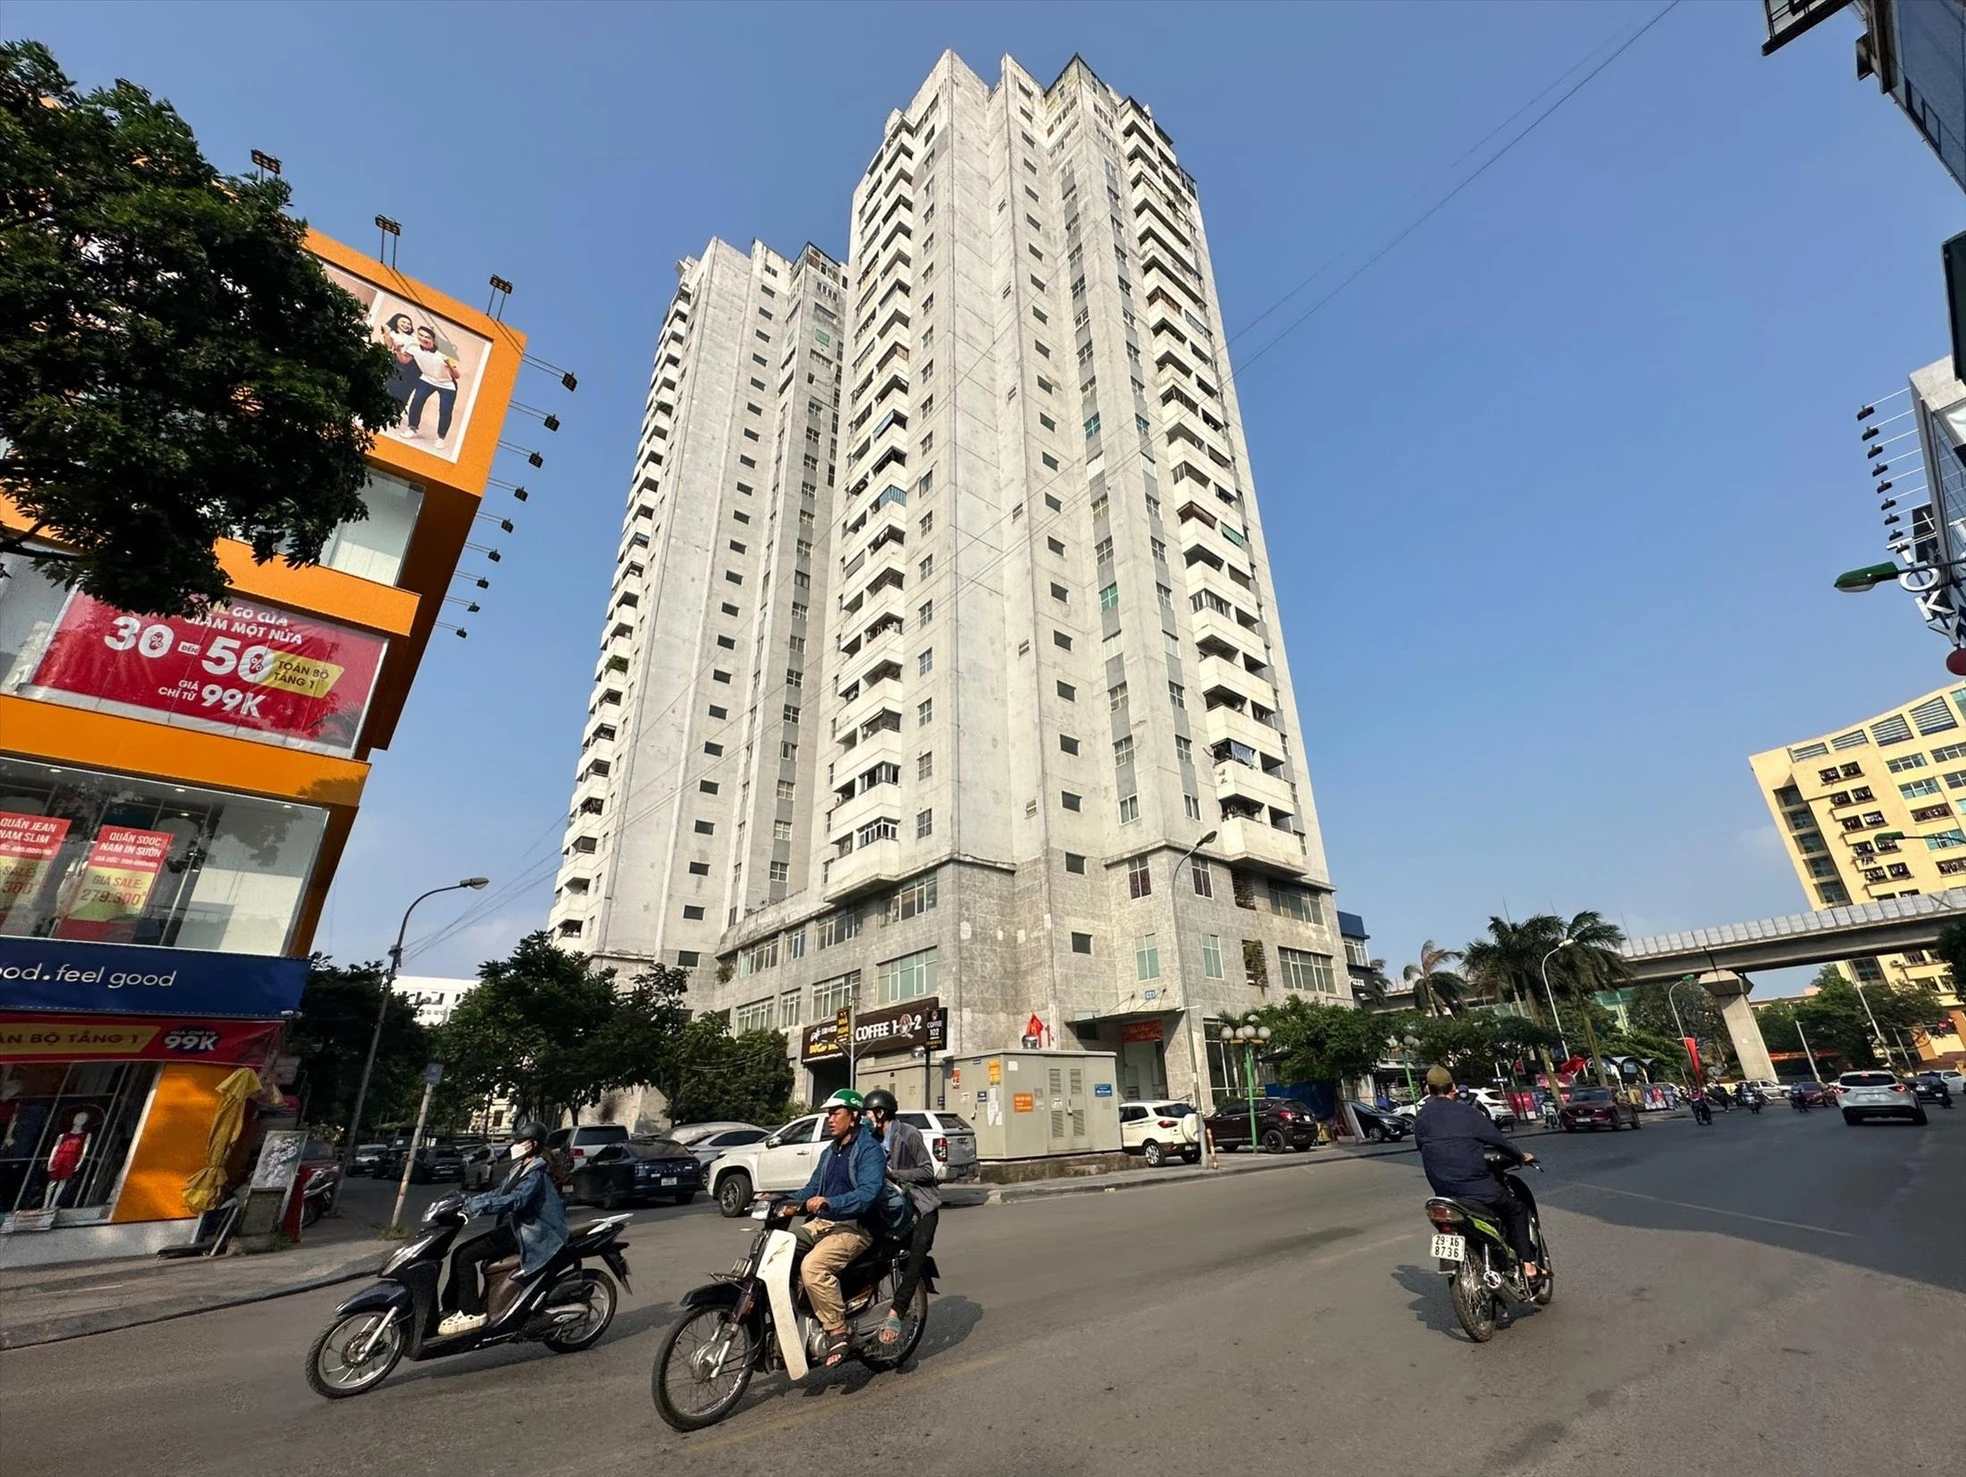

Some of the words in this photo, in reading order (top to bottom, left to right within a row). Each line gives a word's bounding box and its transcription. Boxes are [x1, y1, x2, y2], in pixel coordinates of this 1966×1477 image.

[231, 621, 267, 638] MỘT
[178, 679, 199, 691] GIÁ
[310, 680, 315, 689] 1
[201, 684, 266, 718] 99K
[29, 821, 57, 833] JEAN
[23, 832, 50, 844] SLIM
[100, 842, 122, 853] NAM
[123, 845, 135, 854] IN
[92, 874, 111, 886] GIÁ
[56, 963, 105, 984] feel
[108, 970, 177, 989] good
[855, 1021, 890, 1042] COFFEE
[131, 1034, 139, 1044] 1
[164, 1035, 219, 1051] 99K
[1435, 1246, 1459, 1258] 8736
